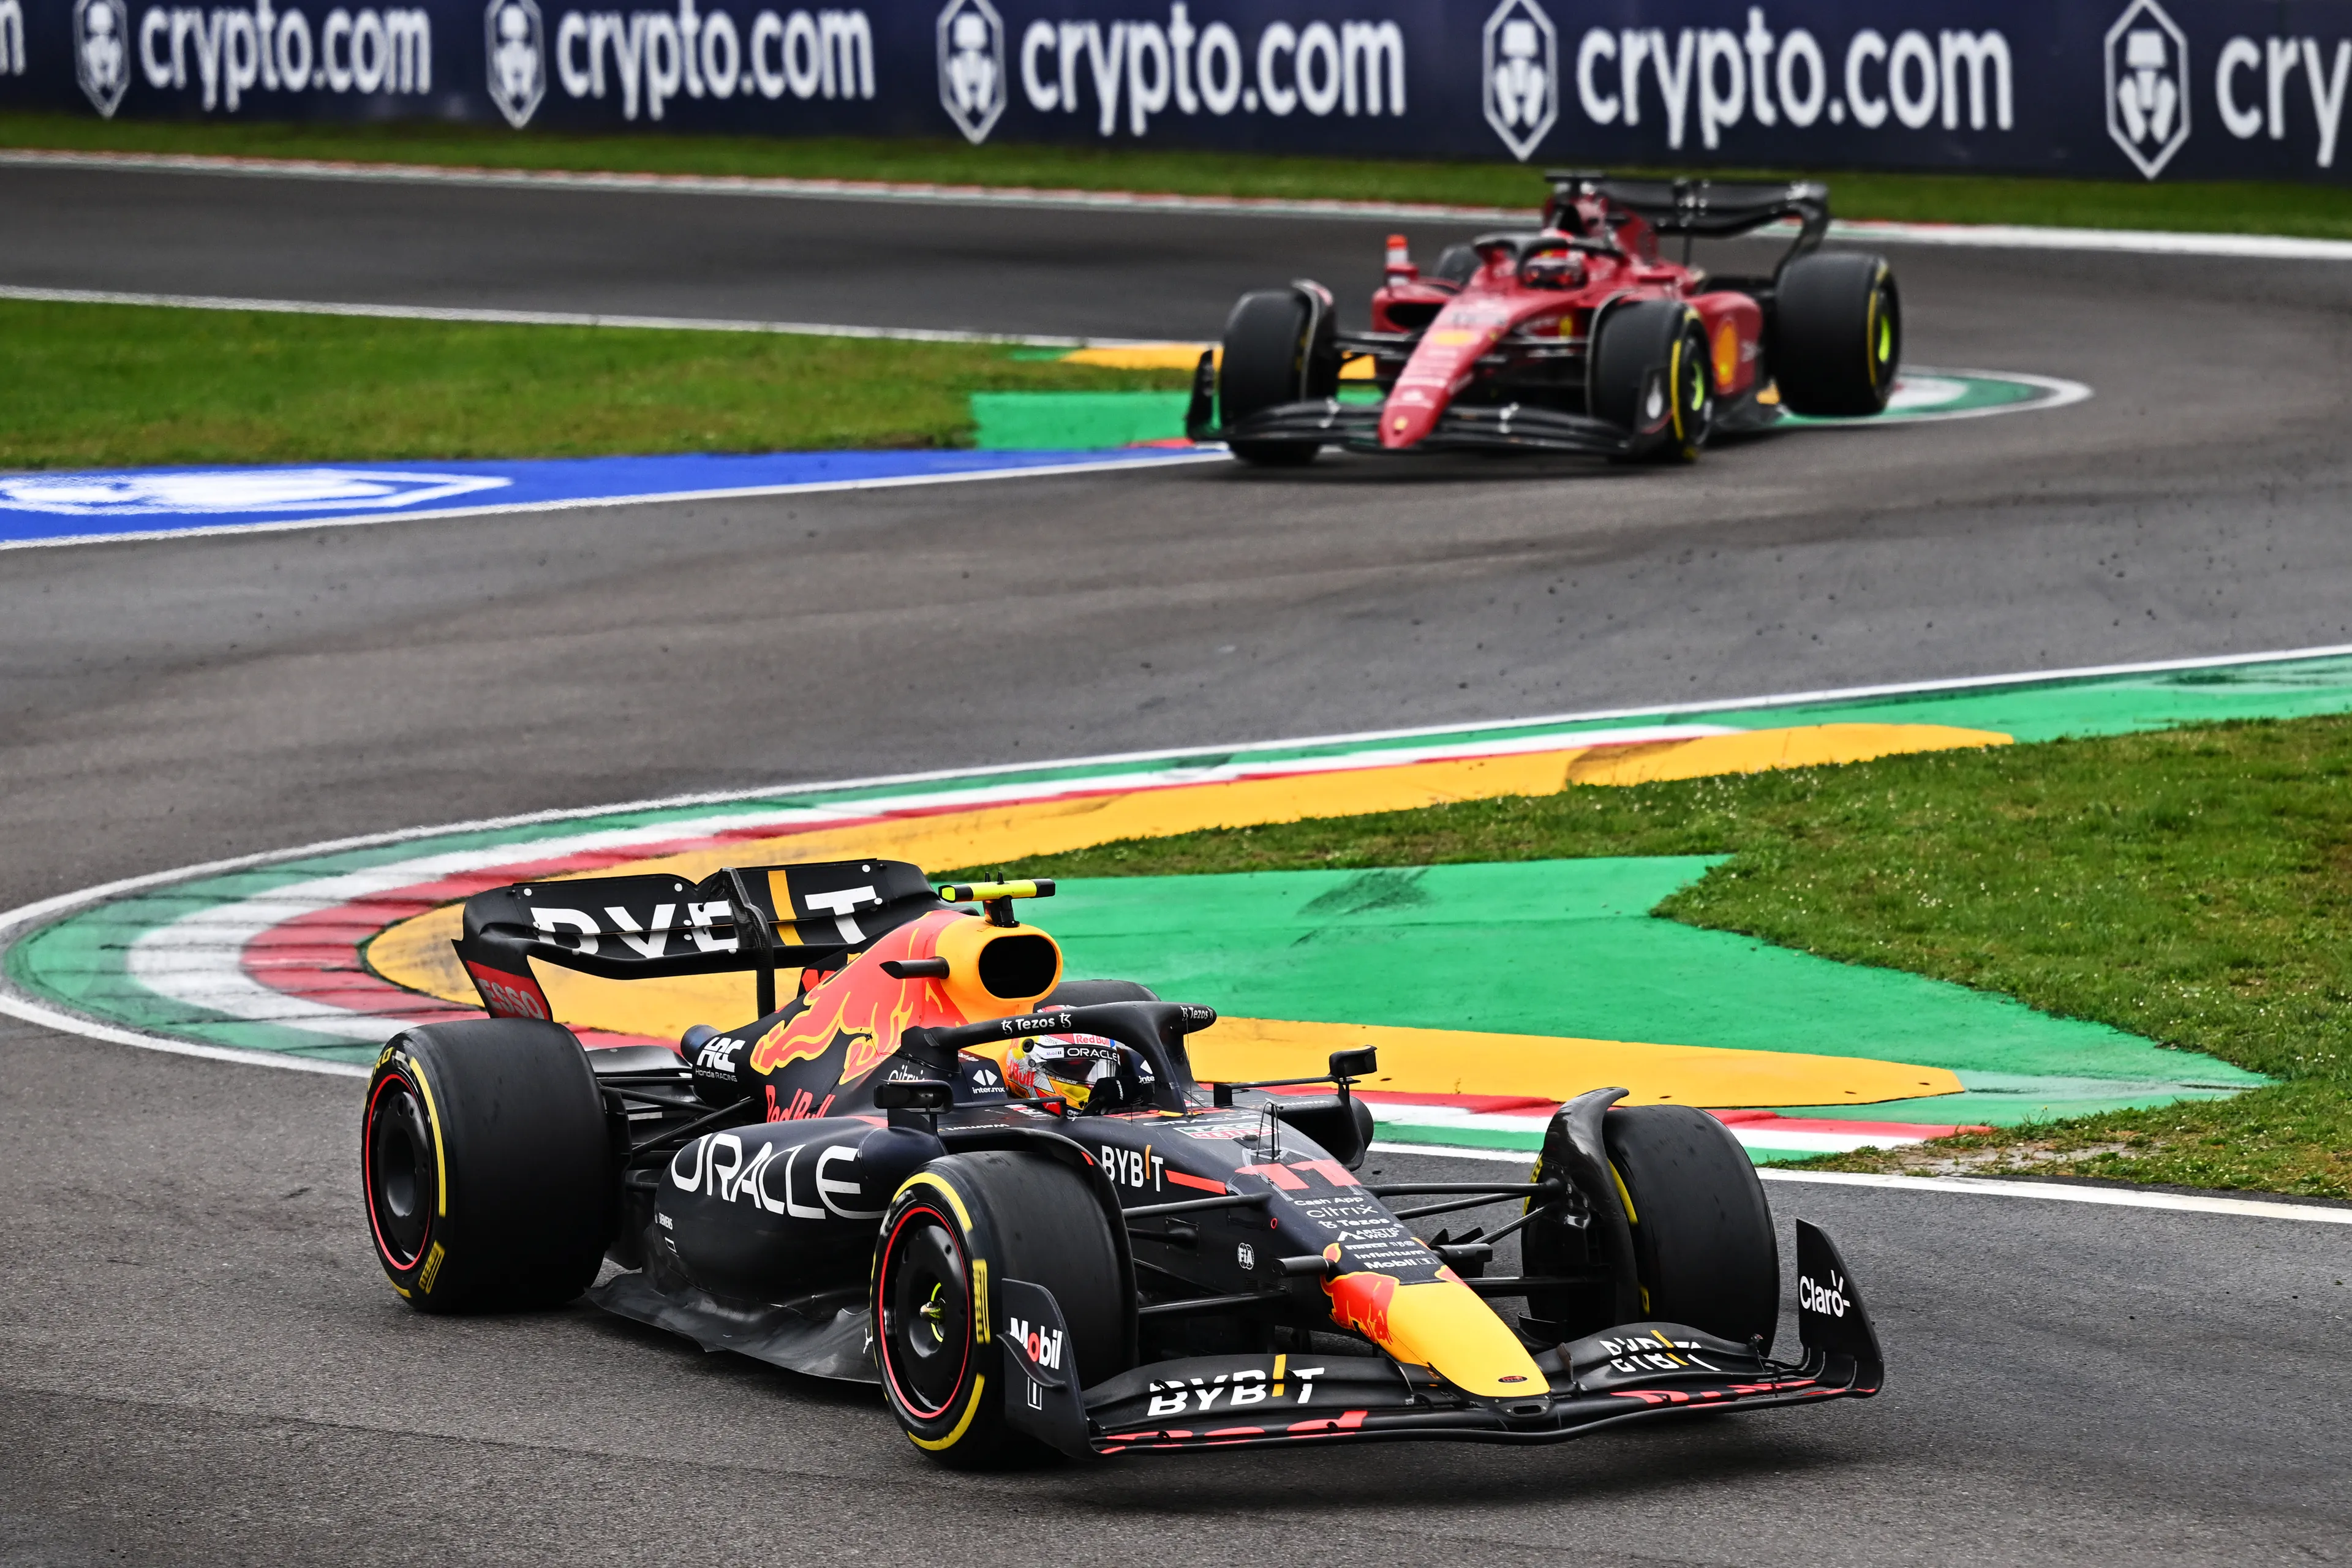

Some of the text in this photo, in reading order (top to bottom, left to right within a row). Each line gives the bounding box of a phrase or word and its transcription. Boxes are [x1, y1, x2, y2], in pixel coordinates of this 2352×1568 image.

[140, 0, 431, 111] crypto.com
[556, 0, 875, 119] crypto.com
[1020, 1, 1406, 136] crypto.com
[1576, 6, 2013, 149] crypto.com
[1188, 1006, 1208, 1019] Tezos
[1015, 1018, 1055, 1031] Tezos
[1076, 1035, 1110, 1047] Red Bull
[1066, 1047, 1118, 1062] ORACLE
[695, 1068, 738, 1082] Honda RACING
[1013, 1062, 1036, 1088] Bull
[1143, 1114, 1262, 1126] ORACLE
[1183, 1123, 1260, 1132] TAG
[671, 1133, 886, 1219] ORACLE
[1101, 1144, 1164, 1192] BYBIT
[1235, 1159, 1362, 1190] 11
[1336, 1218, 1390, 1227] Tezos
[1355, 1227, 1400, 1235] ARCTIC
[1238, 1247, 1254, 1265] FIA
[1363, 1259, 1418, 1270] Mobil
[1800, 1272, 1845, 1317] Claro
[1009, 1317, 1063, 1370] Mobil
[1147, 1354, 1325, 1416] BYBIT
